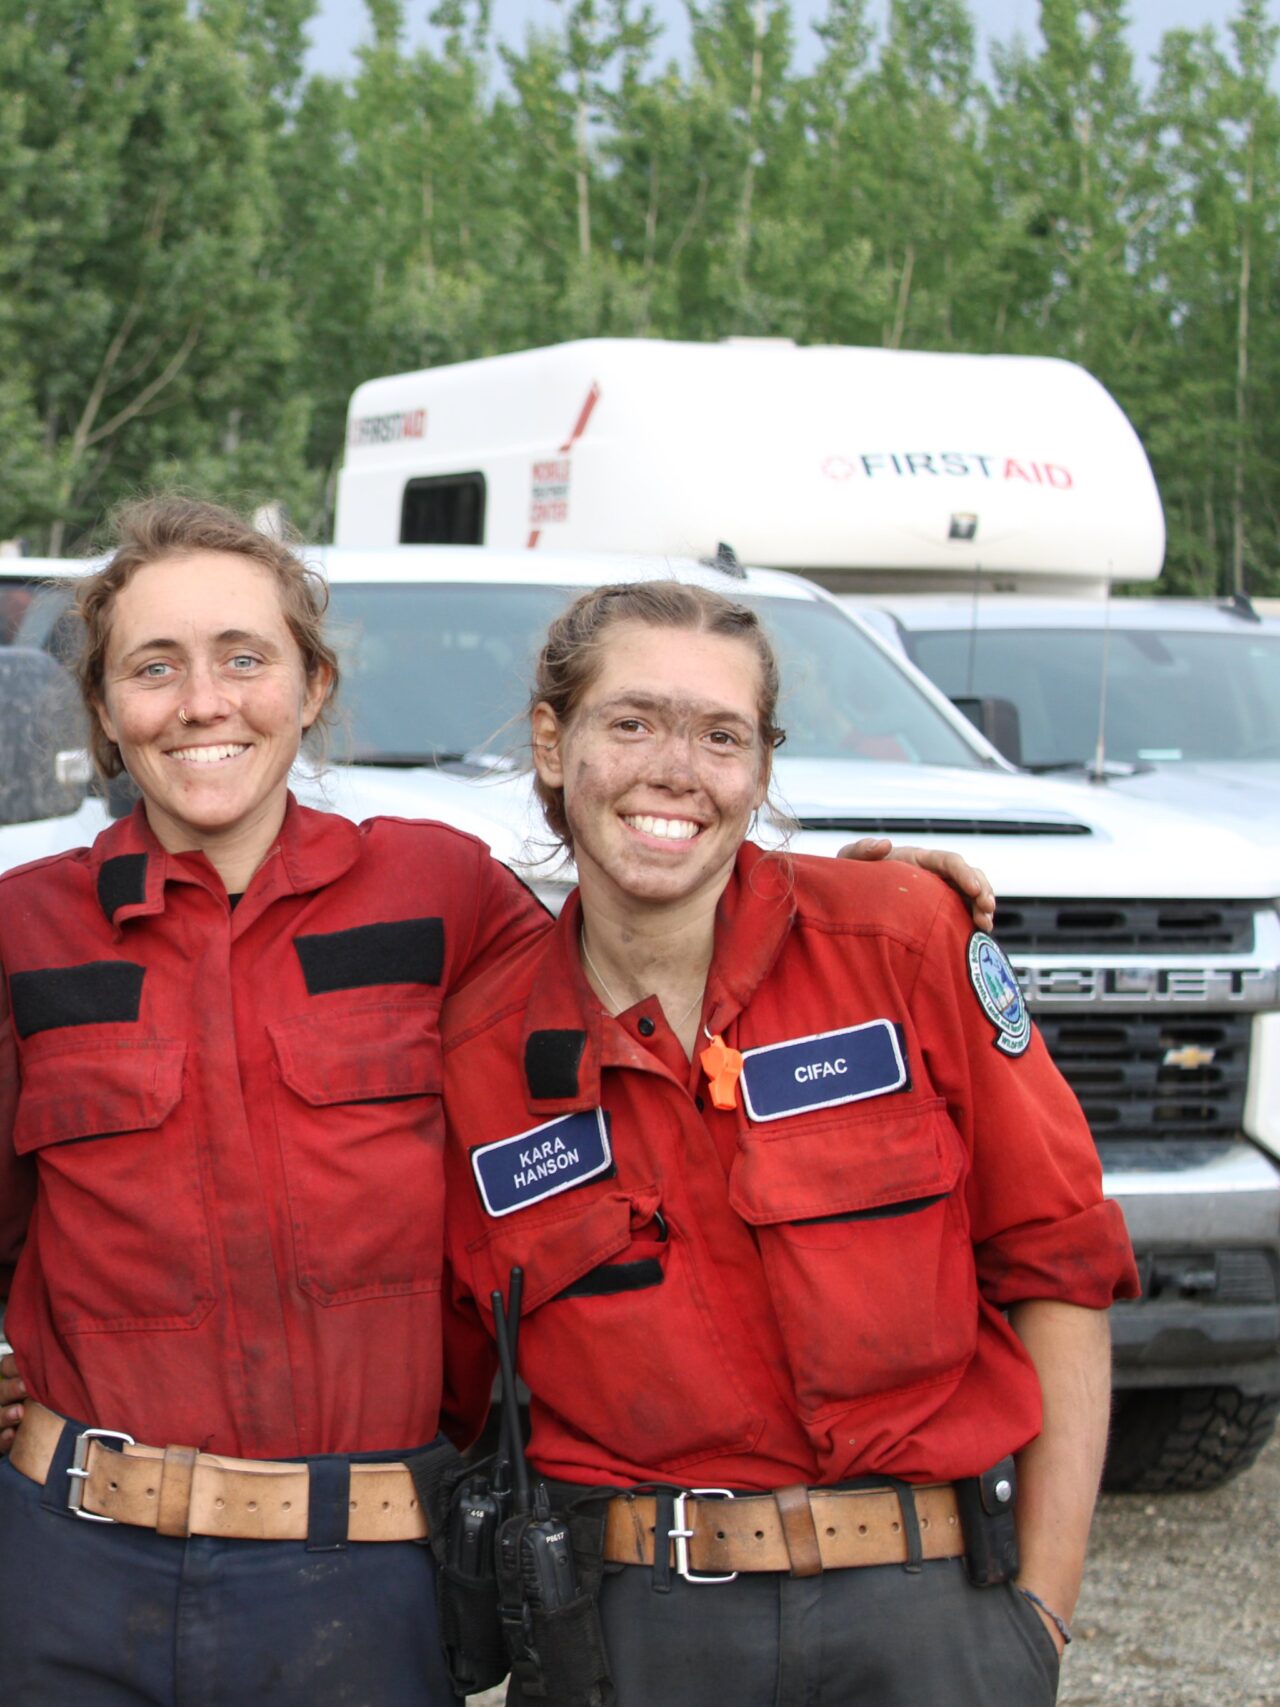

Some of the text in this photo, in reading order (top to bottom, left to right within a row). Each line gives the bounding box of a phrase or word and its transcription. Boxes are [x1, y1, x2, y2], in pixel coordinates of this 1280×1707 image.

[1015, 967, 1266, 1001] OLET
[794, 1058, 848, 1083] CIFAC
[513, 1147, 580, 1189] HANSON
[519, 1136, 566, 1168] KARA
